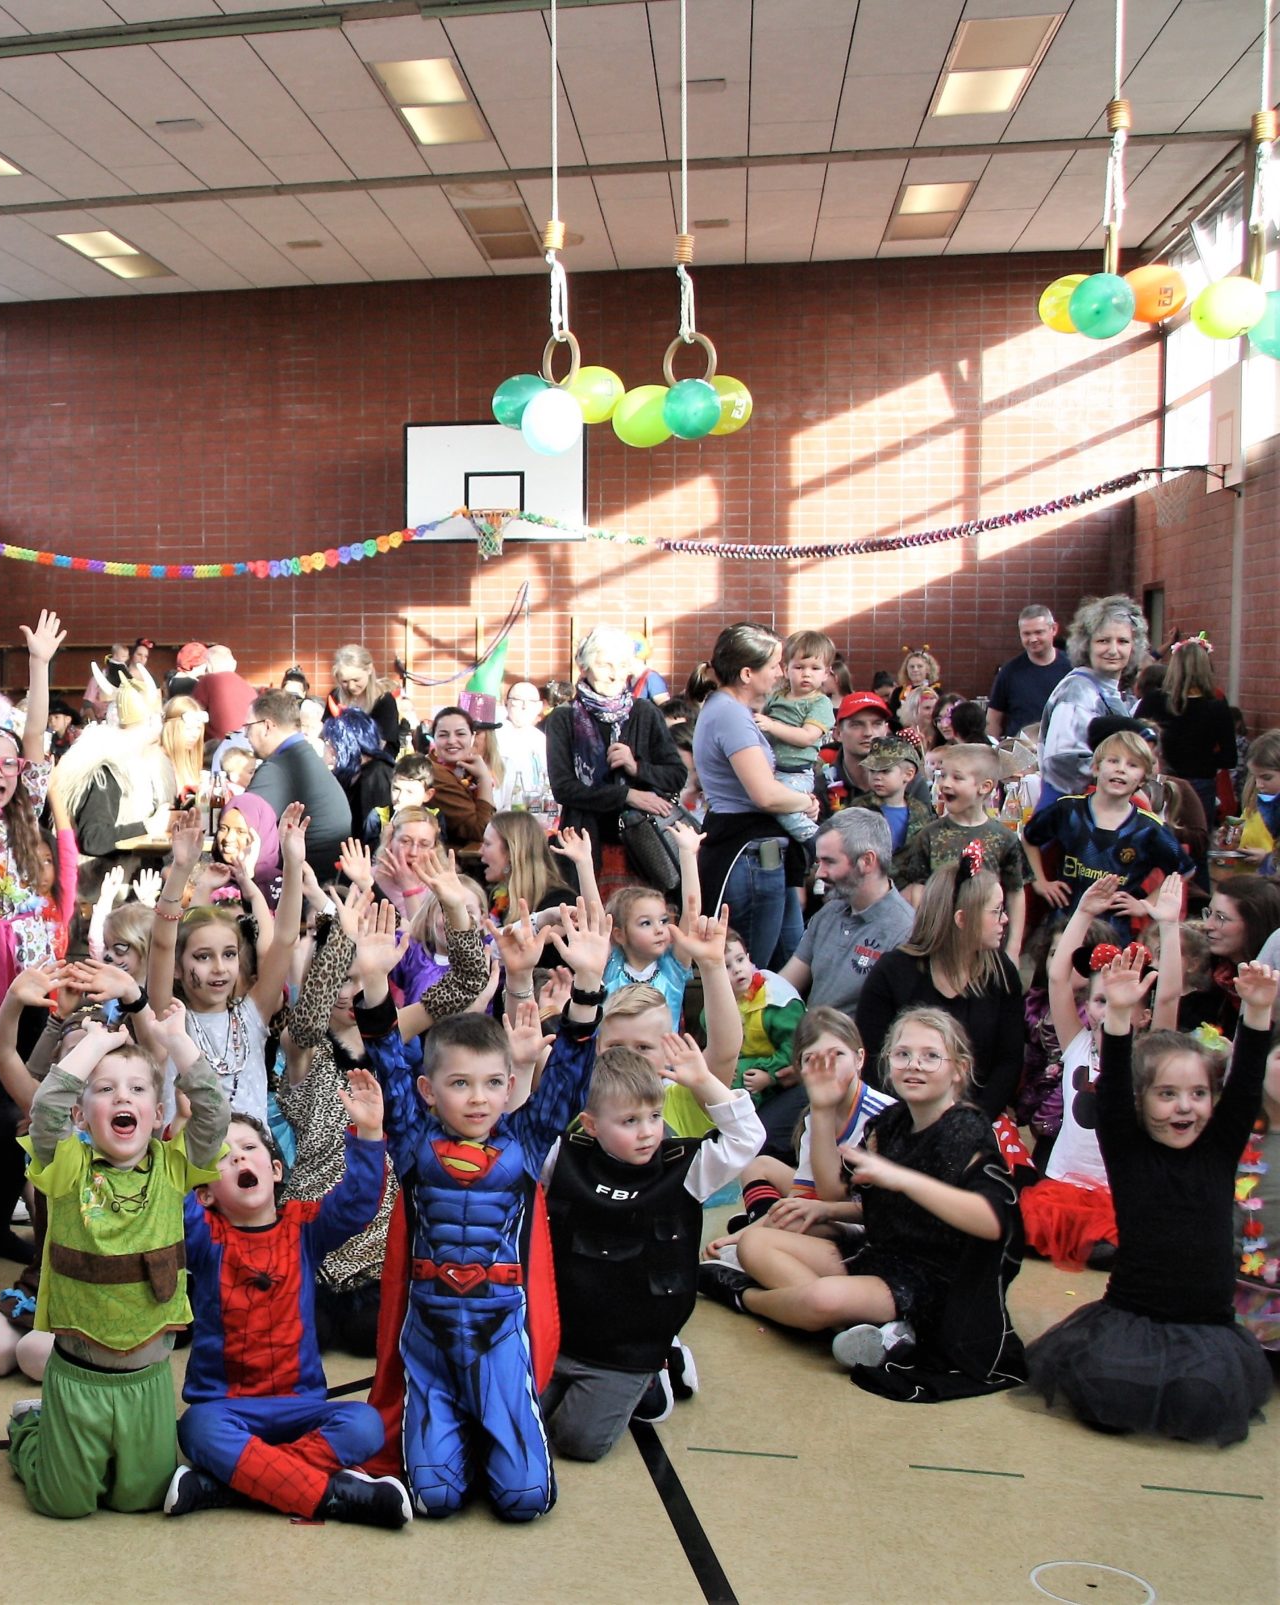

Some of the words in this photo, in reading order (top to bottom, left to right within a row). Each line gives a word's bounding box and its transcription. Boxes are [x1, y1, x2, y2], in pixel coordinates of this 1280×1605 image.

[1076, 862, 1128, 886] TeamVer
[857, 955, 870, 967] 28
[595, 1183, 639, 1201] FBI
